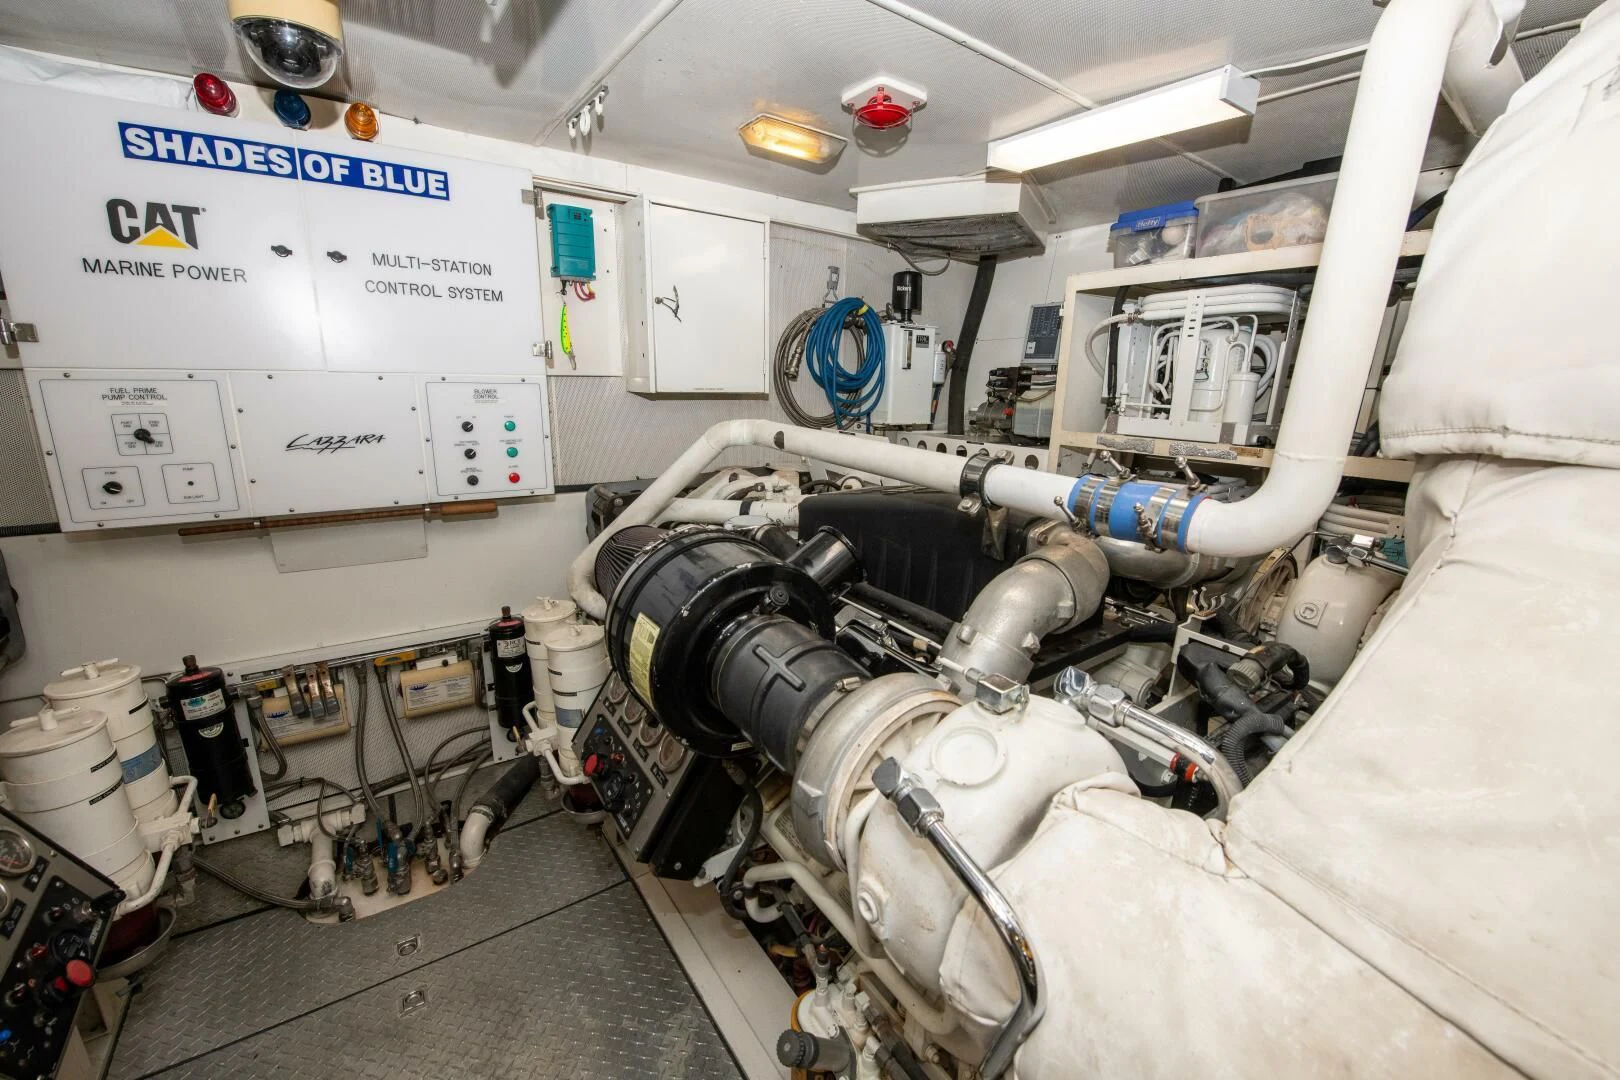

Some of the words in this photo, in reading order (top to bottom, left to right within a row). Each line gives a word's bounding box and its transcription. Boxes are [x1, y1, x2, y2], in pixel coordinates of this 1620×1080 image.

[124, 127, 294, 175] SHADES
[303, 153, 350, 182] OF
[361, 162, 447, 197] BLUE
[106, 198, 201, 250] CAT
[82, 257, 165, 278] MARINE
[172, 264, 248, 283] POWER
[372, 252, 492, 276] MULTI-STATION
[364, 279, 443, 298] CONTROL
[447, 286, 504, 302] SYSTEM
